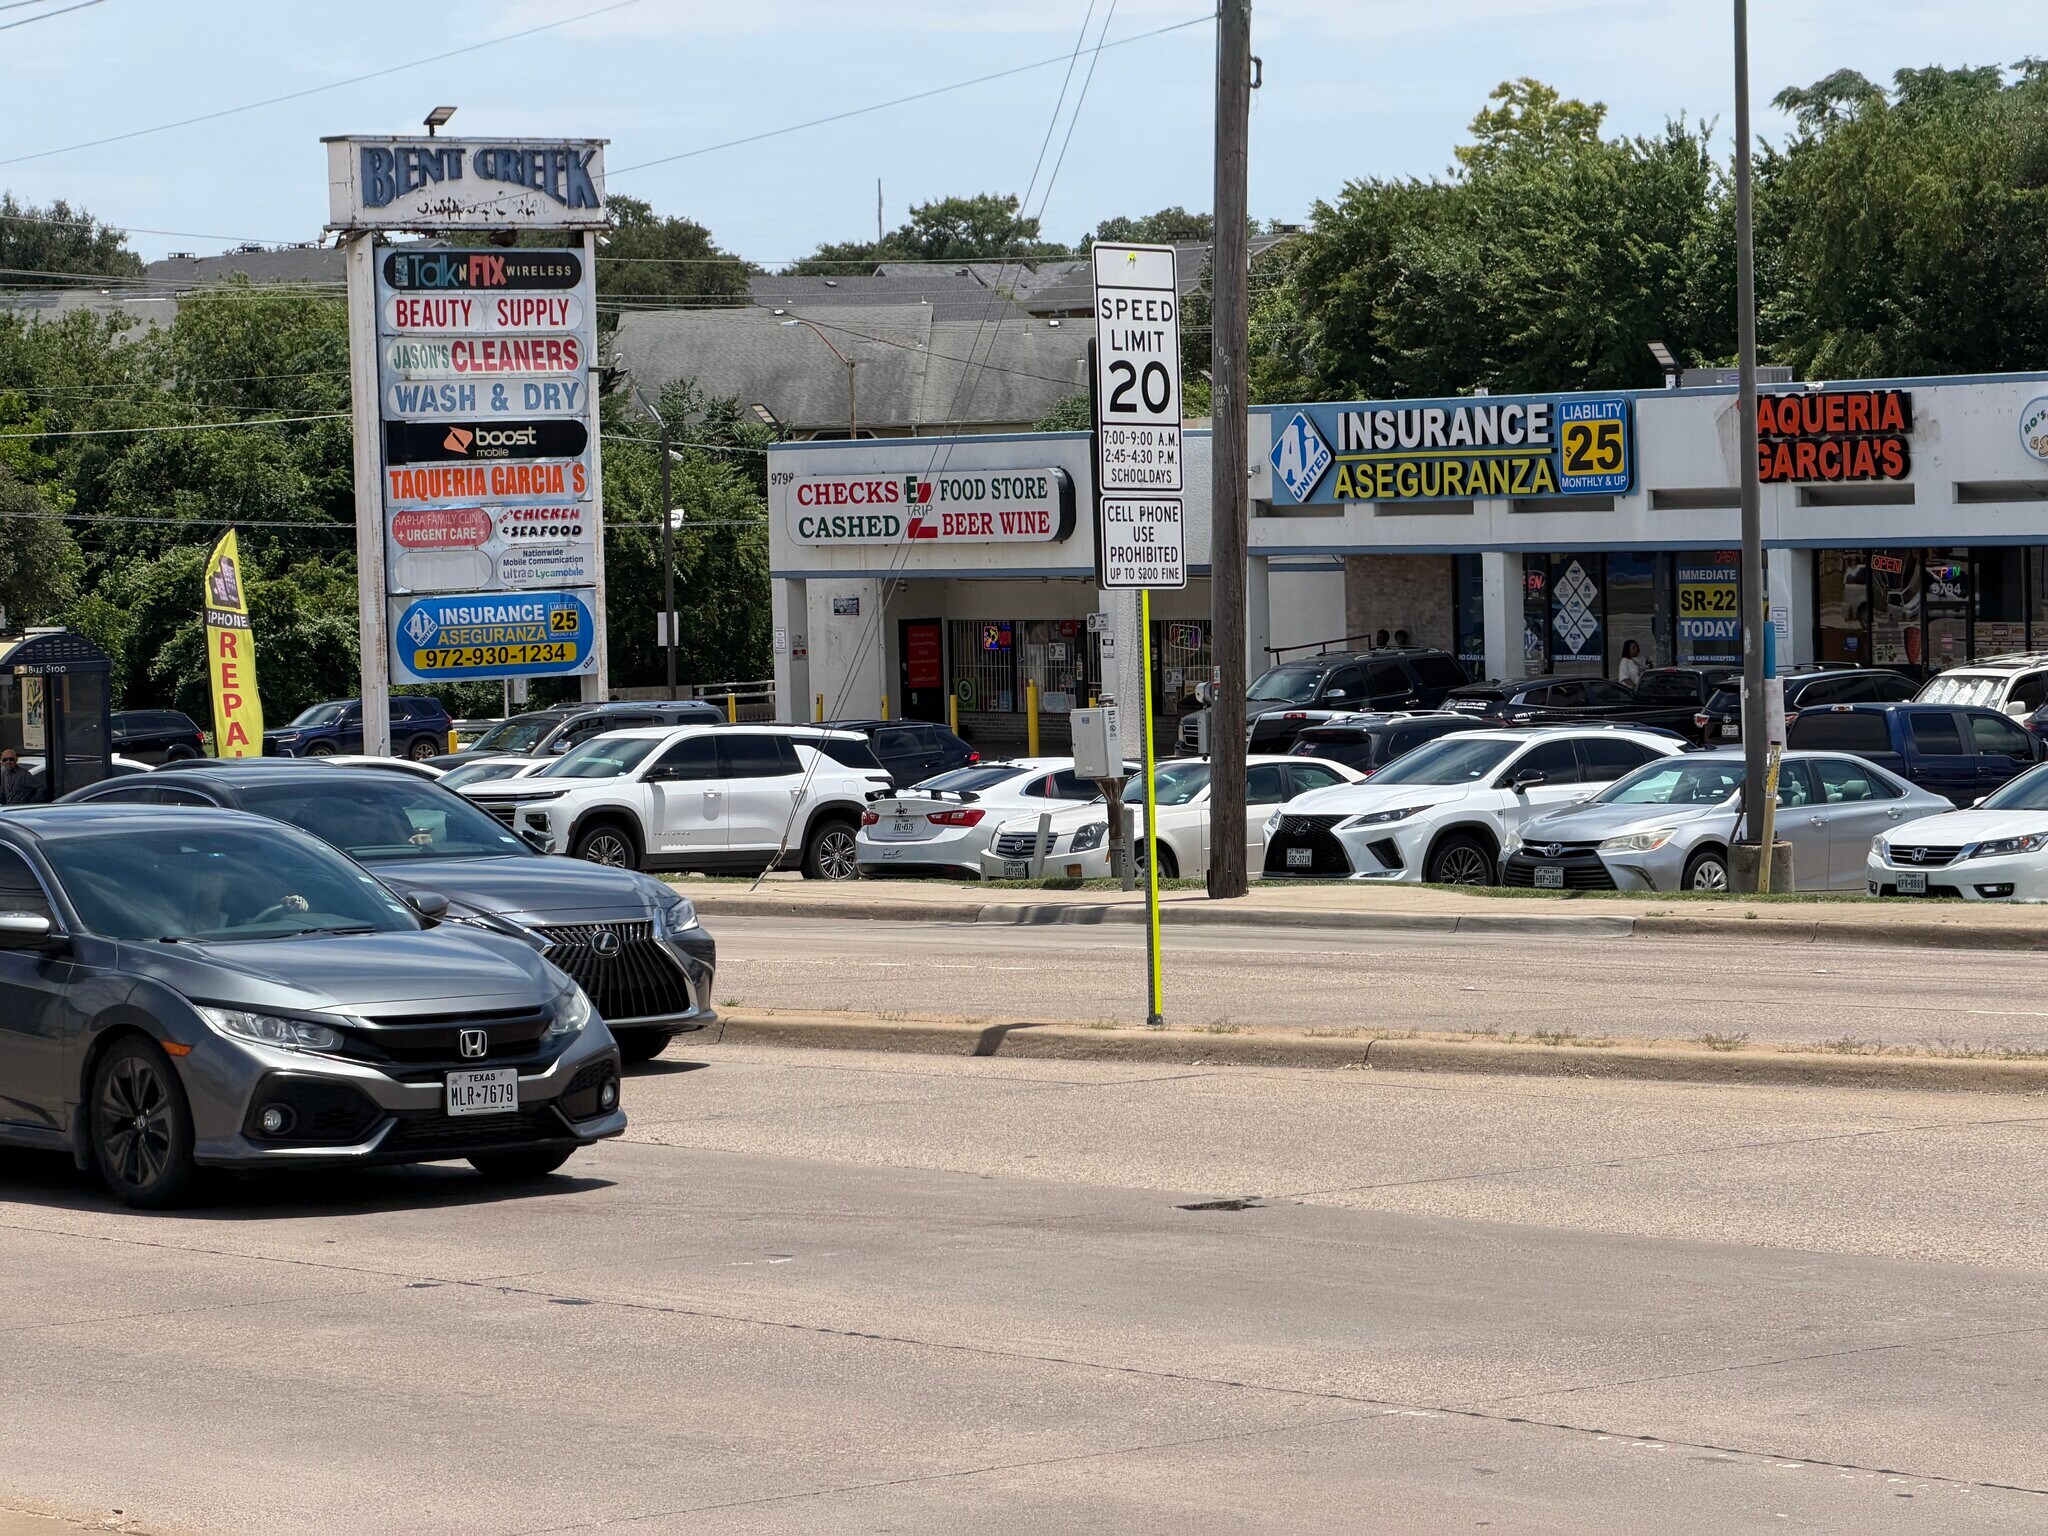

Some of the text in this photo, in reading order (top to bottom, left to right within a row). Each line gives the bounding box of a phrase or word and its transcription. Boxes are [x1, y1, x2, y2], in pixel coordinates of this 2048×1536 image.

[360, 146, 466, 208] BENT
[473, 147, 600, 209] CREEK
[469, 255, 507, 287] FIX
[506, 265, 571, 277] WIRELESS
[396, 298, 570, 327] BEAUTY SUPPLY
[1101, 297, 1173, 322] SPEED
[1111, 329, 1164, 352] LIMIT
[393, 339, 579, 372] JASON'S CLEANERS
[1108, 360, 1171, 414] 20
[395, 381, 579, 413] WASH & DRY
[1562, 402, 1622, 420] LIABILITY
[1737, 393, 1905, 436] AQUERIA
[475, 426, 537, 446] boost
[1338, 403, 1549, 450] INSURANCE
[1104, 430, 1178, 447] 7:00-9:00 A.M.
[476, 447, 509, 458] mobile
[1105, 448, 1177, 465] 2:45-4:30 P.M.
[1758, 438, 1904, 480] GARCIA'S
[1293, 449, 1329, 499] UNITED
[1334, 458, 1555, 499] ASEGURANZA
[1561, 475, 1626, 488] MONTHLY & UP
[389, 467, 487, 501] TAQUERIA
[797, 481, 899, 506] CHECKS
[940, 477, 1048, 501] FOOD STORE
[395, 513, 486, 526] RAPHA FAMILY CLINIC
[513, 508, 581, 521] CHICKEN
[905, 505, 933, 516] TRIP
[1108, 505, 1179, 523] CELL PHONE
[511, 525, 583, 538] SEAFOOD
[799, 514, 900, 539] CASHED
[942, 511, 1051, 535] BEER WINE
[406, 527, 477, 541] URGENT CARE
[1133, 526, 1154, 543] USE
[503, 556, 584, 566] Mobile Communication
[523, 548, 563, 557] Nationwide
[1110, 546, 1178, 563] PROHIBITED
[1714, 551, 1738, 563] OPEN
[503, 567, 584, 579] ultra Lycamobile
[1110, 566, 1179, 580] UP TO $200 FINE
[1873, 557, 1900, 572] OPEN
[1678, 570, 1737, 581] IMMEDIATE
[1931, 583, 1962, 594] 9794
[550, 603, 578, 611] LIABILITY
[1680, 589, 1736, 611] SR-22
[207, 610, 248, 627] iPHONE
[439, 604, 544, 625] INSURANCE
[418, 623, 437, 646] UNITED
[437, 626, 547, 646] ASEGURANZA
[1680, 621, 1737, 637] TODAY
[426, 643, 566, 668] 972-930-1234
[218, 631, 250, 757] REPA
[468, 1073, 496, 1082] TEXAS
